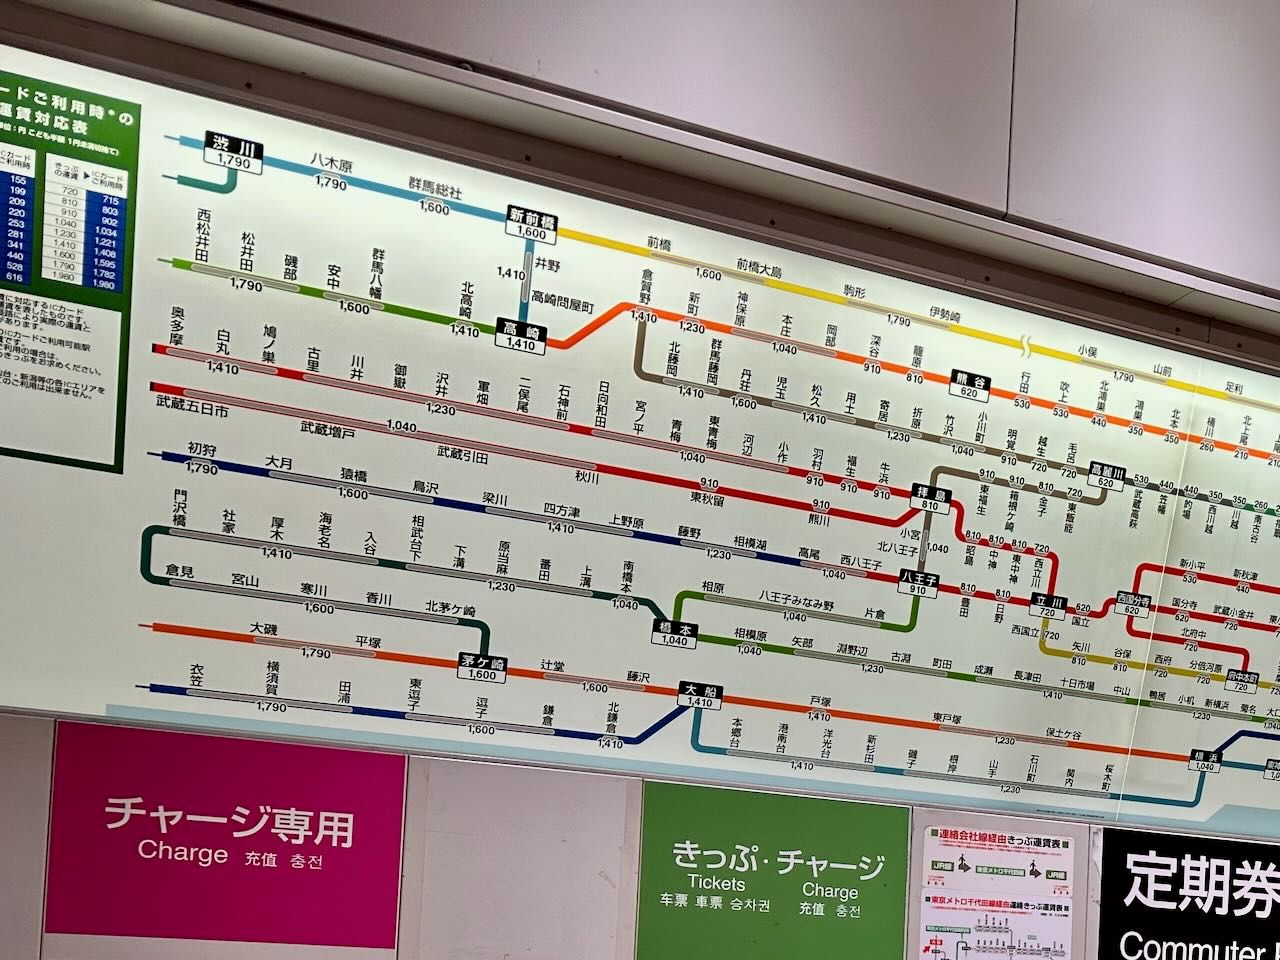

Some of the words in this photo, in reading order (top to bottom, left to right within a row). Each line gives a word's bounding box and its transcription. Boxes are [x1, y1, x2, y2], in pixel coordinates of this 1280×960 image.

[212, 135, 256, 158] 渋川
[217, 154, 251, 170] 1,790
[310, 152, 353, 173] 八木原
[408, 176, 462, 201] 群馬総社
[509, 208, 556, 231] 新前橋
[195, 208, 211, 262] 西松井田
[517, 225, 546, 240] 1,600
[284, 254, 298, 280] 磯部
[369, 248, 386, 300] 群馬八幡
[736, 257, 782, 279] 前橋大島
[338, 299, 370, 316] 1,600
[532, 290, 594, 314] 高崎問屋町
[929, 306, 961, 324] 伊勢崎
[170, 306, 184, 346] 奥多摩
[503, 321, 540, 340] 高崎
[780, 314, 793, 337] 本庄
[262, 324, 277, 363] 鳩ノ巣
[506, 337, 536, 351] 1,410
[955, 372, 986, 390] 熊谷
[1225, 381, 1243, 394] 足利
[961, 387, 978, 399] 620
[156, 394, 229, 419] 武蔵五日市
[300, 421, 356, 439] 武蔵増戸
[188, 441, 217, 457] 初狩
[266, 456, 292, 470] 大月
[1098, 478, 1113, 487] 620
[543, 502, 581, 519] 四方津
[921, 500, 938, 511] 810
[318, 512, 332, 549] 海老名
[733, 536, 767, 550] 相模湖
[621, 561, 634, 593] 南橋本
[901, 571, 938, 587] 八王子
[301, 582, 328, 598] 寒川
[909, 584, 926, 596] 910
[758, 590, 835, 612] 八王子みなみ野
[1036, 595, 1062, 609] 立川
[1039, 607, 1055, 617] 720
[659, 622, 692, 636] 橋本
[661, 635, 688, 647] 1,040
[265, 660, 280, 696] 横須賀
[468, 669, 497, 681] 1,600
[684, 683, 718, 698] 大船
[688, 697, 713, 708] 1,410
[933, 712, 962, 725] 東戸塚
[1196, 762, 1215, 771] 1,040
[104, 796, 354, 848] チャージ専用
[138, 839, 229, 867] Charge
[290, 853, 323, 870] 충전
[672, 840, 886, 881] きっぷ・チャージ
[687, 874, 746, 891] Tickets
[802, 882, 858, 902] Charge
[730, 898, 770, 912] 승차권
[836, 905, 861, 918] 충전
